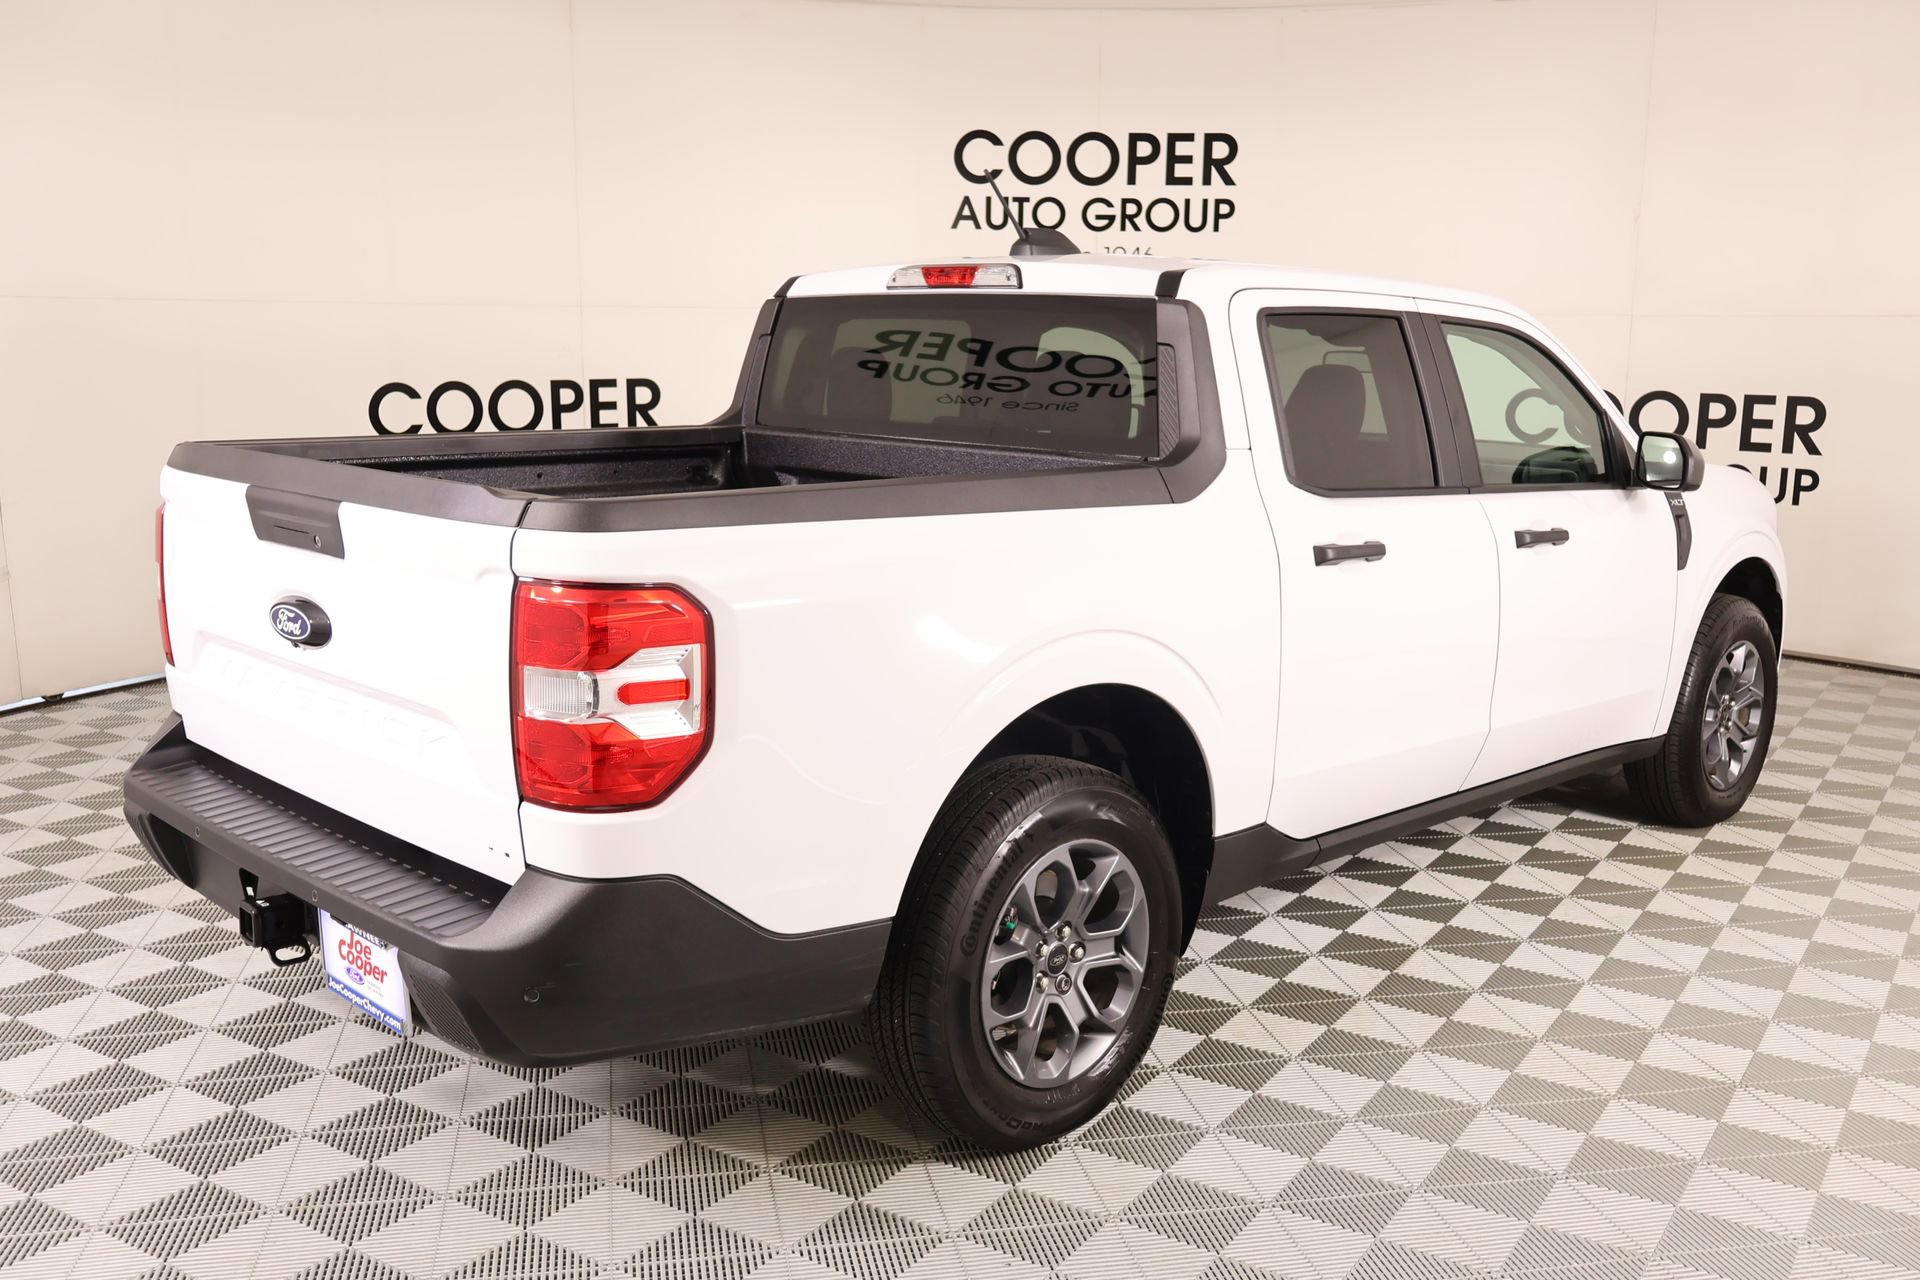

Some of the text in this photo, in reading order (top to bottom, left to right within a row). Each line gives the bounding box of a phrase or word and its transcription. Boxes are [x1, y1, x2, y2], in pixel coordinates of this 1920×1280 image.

[954, 129, 1239, 186] COOPER
[951, 195, 1236, 232] AUTO GROUP
[369, 378, 661, 436] COOPER
[276, 608, 302, 636] Ford
[338, 939, 388, 984] Cooper
[347, 930, 372, 961] Joe
